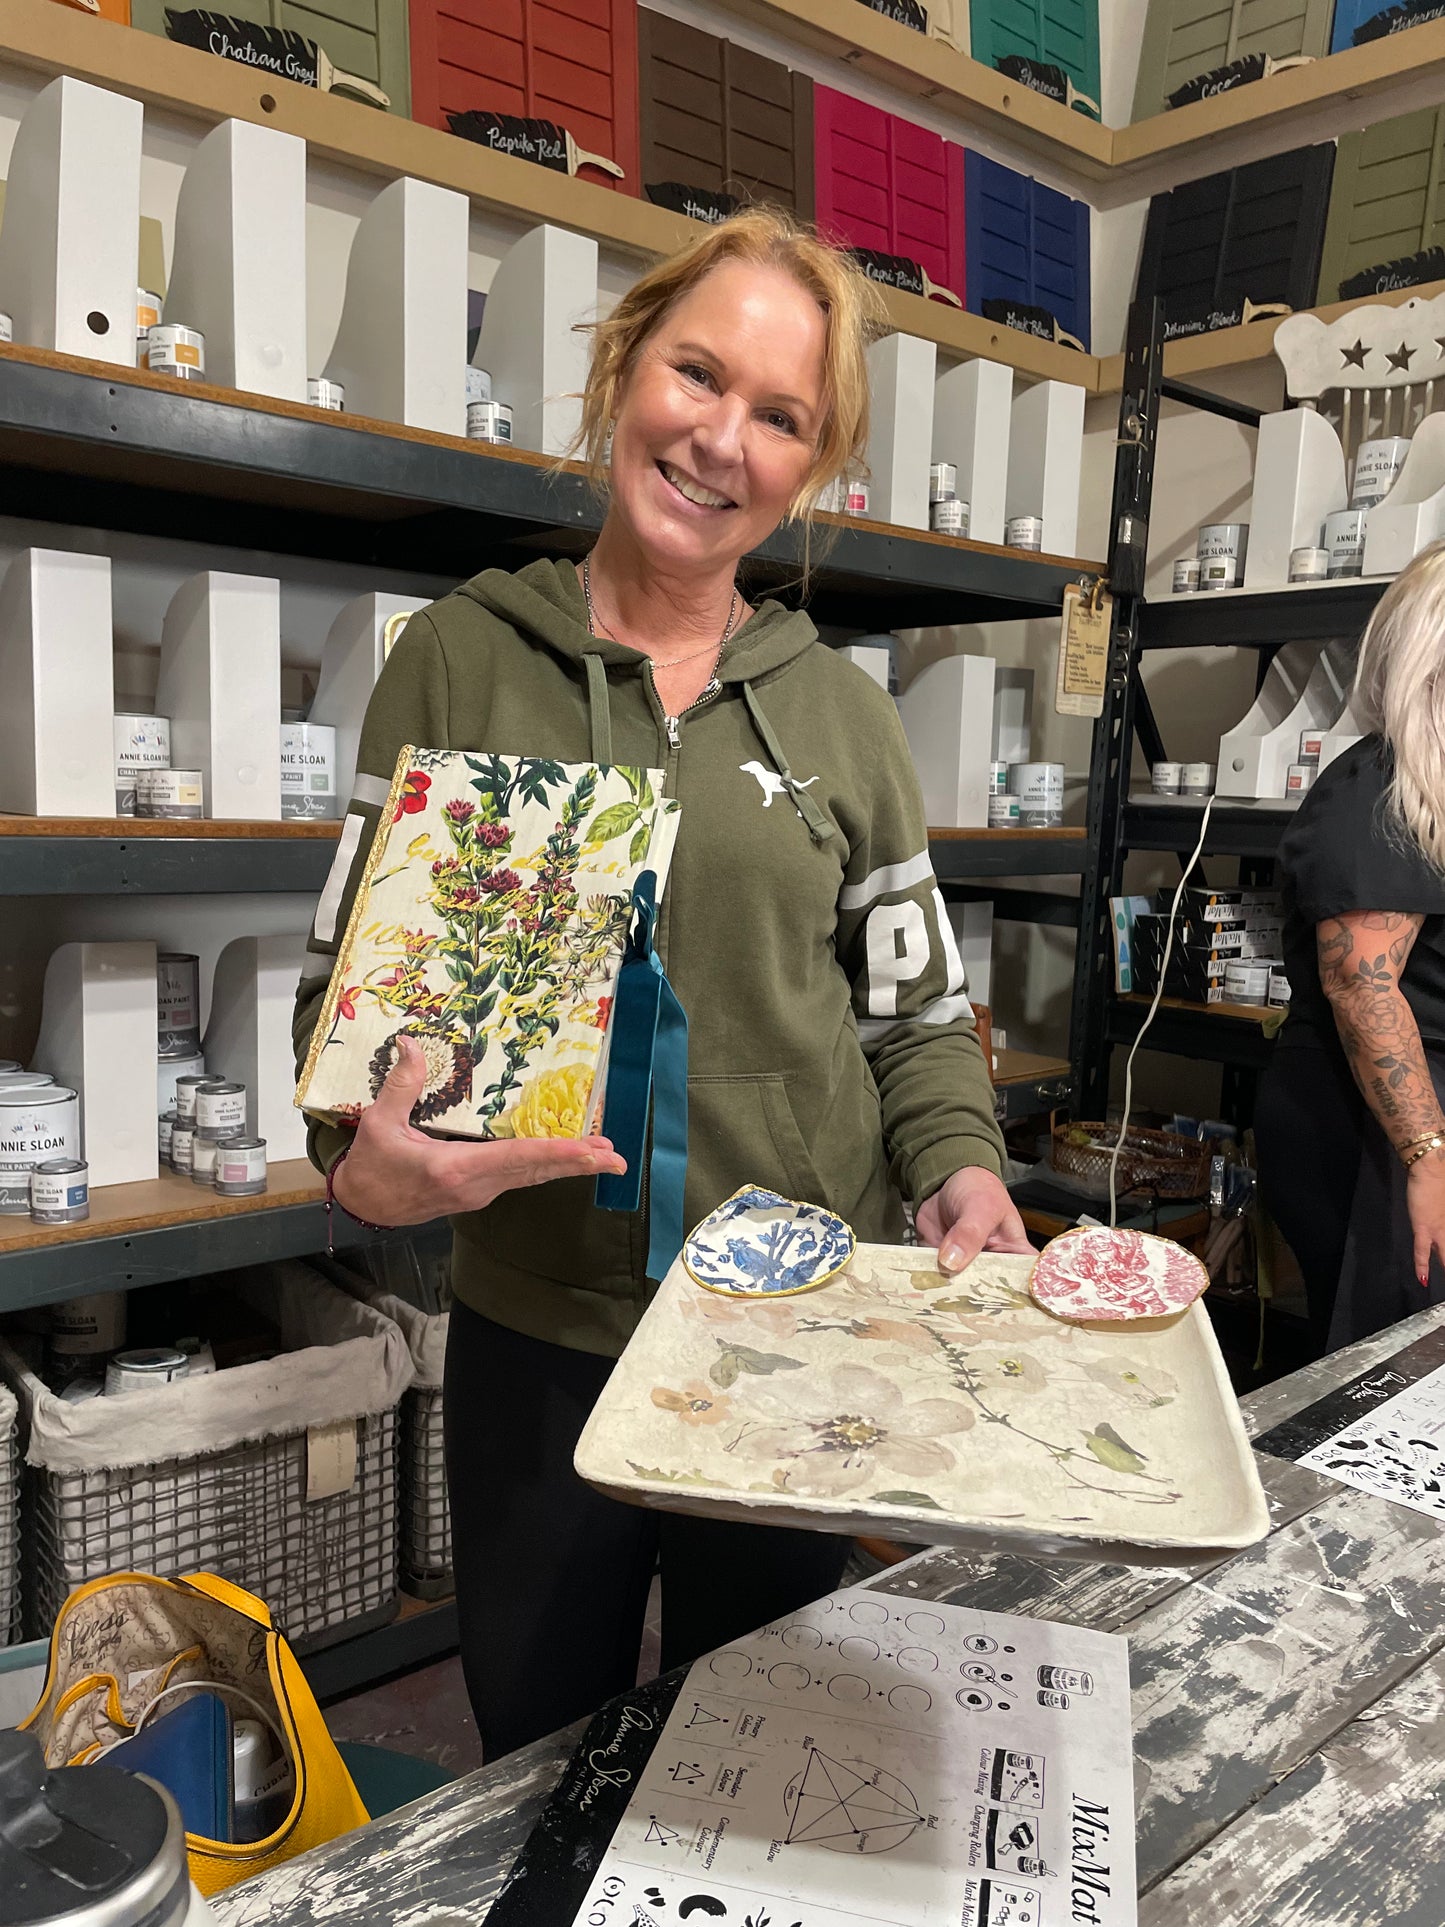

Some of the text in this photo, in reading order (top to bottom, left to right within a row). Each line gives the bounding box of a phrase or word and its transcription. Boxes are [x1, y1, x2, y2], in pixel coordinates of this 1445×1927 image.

[209, 31, 319, 86] Chateau Grey
[1201, 74, 1241, 100] Coco
[487, 127, 566, 161] Paprika Red
[865, 262, 922, 291] Capri Pink
[1376, 272, 1419, 294] Olive
[1006, 311, 1053, 339] Greek Blue
[1206, 311, 1240, 330] Black
[1374, 462, 1399, 471] SLOAN
[1336, 534, 1359, 543] ANNIE
[1210, 547, 1234, 556] SLOAN
[119, 753, 141, 761] ANNIE
[143, 754, 161, 762] SLOAN
[299, 754, 326, 765] SLOAN
[30, 1136, 65, 1151] SLOAN
[739, 1714, 753, 1735] Colours
[750, 1715, 766, 1738] Primary
[801, 1735, 814, 1750] Blue
[579, 1706, 653, 1812] Annie Sloan
[717, 1768, 734, 1793] Colours
[727, 1767, 748, 1799] Secondary
[974, 1748, 991, 1796] Colour Mixing
[927, 1814, 939, 1830] Red
[695, 1826, 712, 1854] Colours
[701, 1816, 730, 1872] Complementary
[968, 1804, 985, 1868] Charging Rollers
[766, 1838, 783, 1863] Yellow
[1071, 1792, 1111, 1925] MixMat
[964, 1879, 977, 1901] Mark
